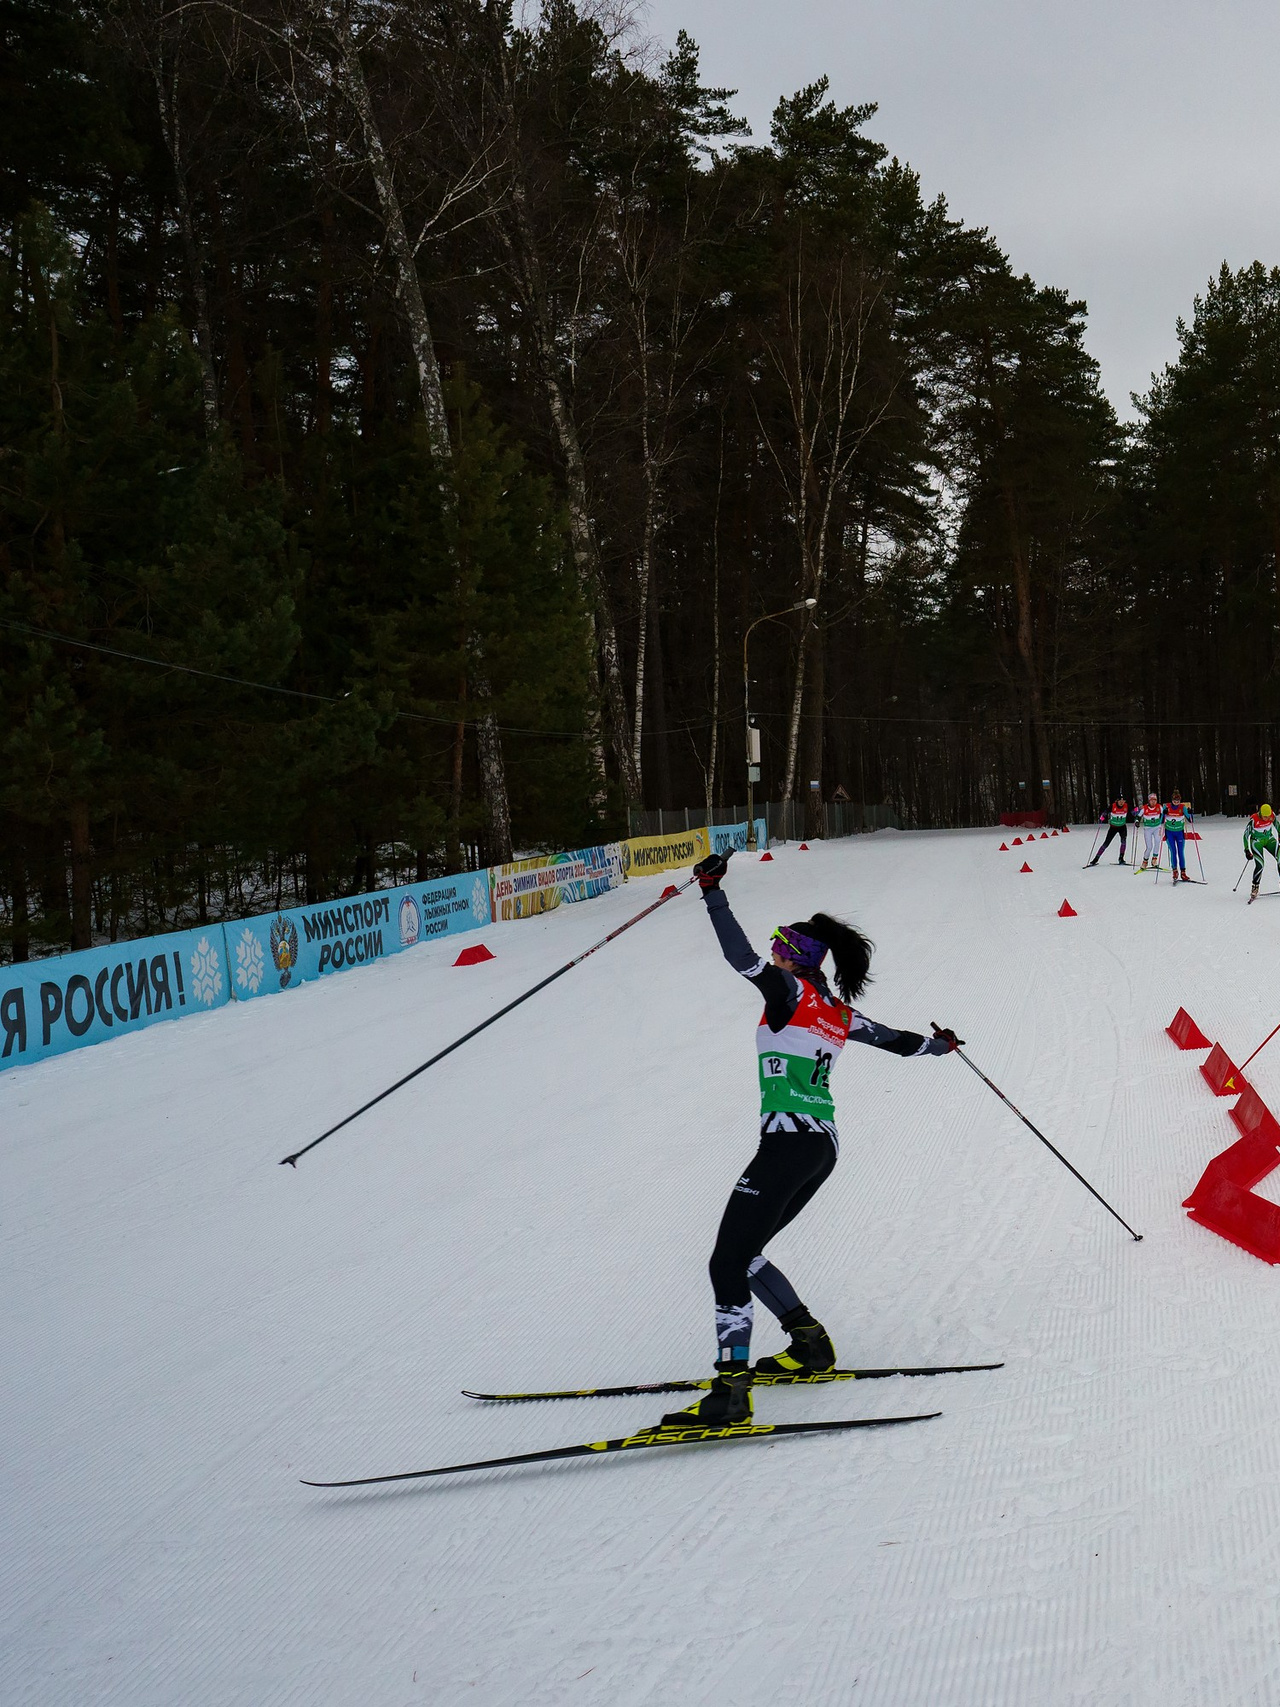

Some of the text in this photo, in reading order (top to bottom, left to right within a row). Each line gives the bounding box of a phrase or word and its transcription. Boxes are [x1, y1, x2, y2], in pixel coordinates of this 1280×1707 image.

[496, 880, 513, 899] ДЕНЬ
[513, 874, 538, 893] ЗИМНИХ
[538, 870, 556, 888] ВИДОВ
[556, 866, 575, 882] СПОРТА
[422, 887, 457, 905] ФЕДЕРАЦИЯ
[302, 897, 390, 943] МИНСПОРТ
[424, 898, 469, 920] ЛЫЖНЫХ ГОНОК
[425, 919, 448, 936] РОССИИ
[318, 929, 384, 973] РОССИИ
[40, 951, 186, 1046] РОССИЯ!
[768, 1058, 782, 1075] 12
[620, 1424, 775, 1448] FISCHER
